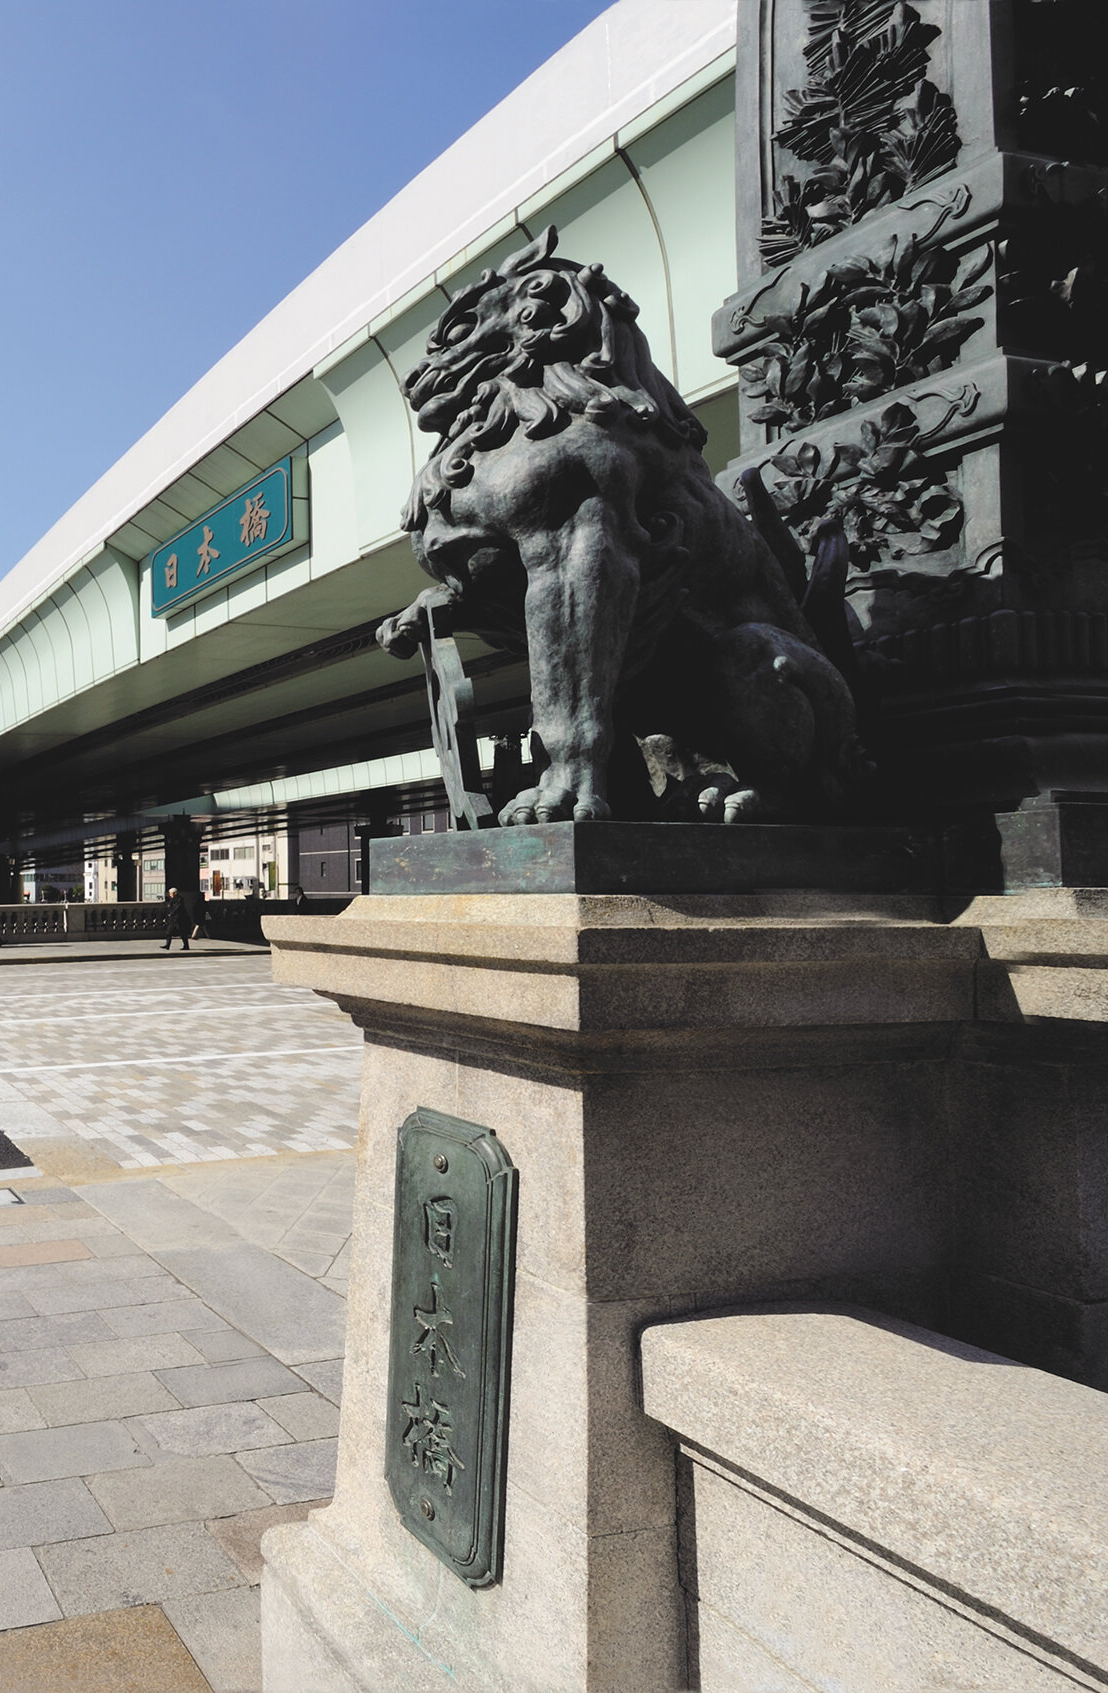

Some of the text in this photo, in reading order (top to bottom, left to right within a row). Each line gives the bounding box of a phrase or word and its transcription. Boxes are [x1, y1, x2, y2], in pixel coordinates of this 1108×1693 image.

[164, 491, 271, 588] 日本橋
[401, 1196, 466, 1497] 日本橋
